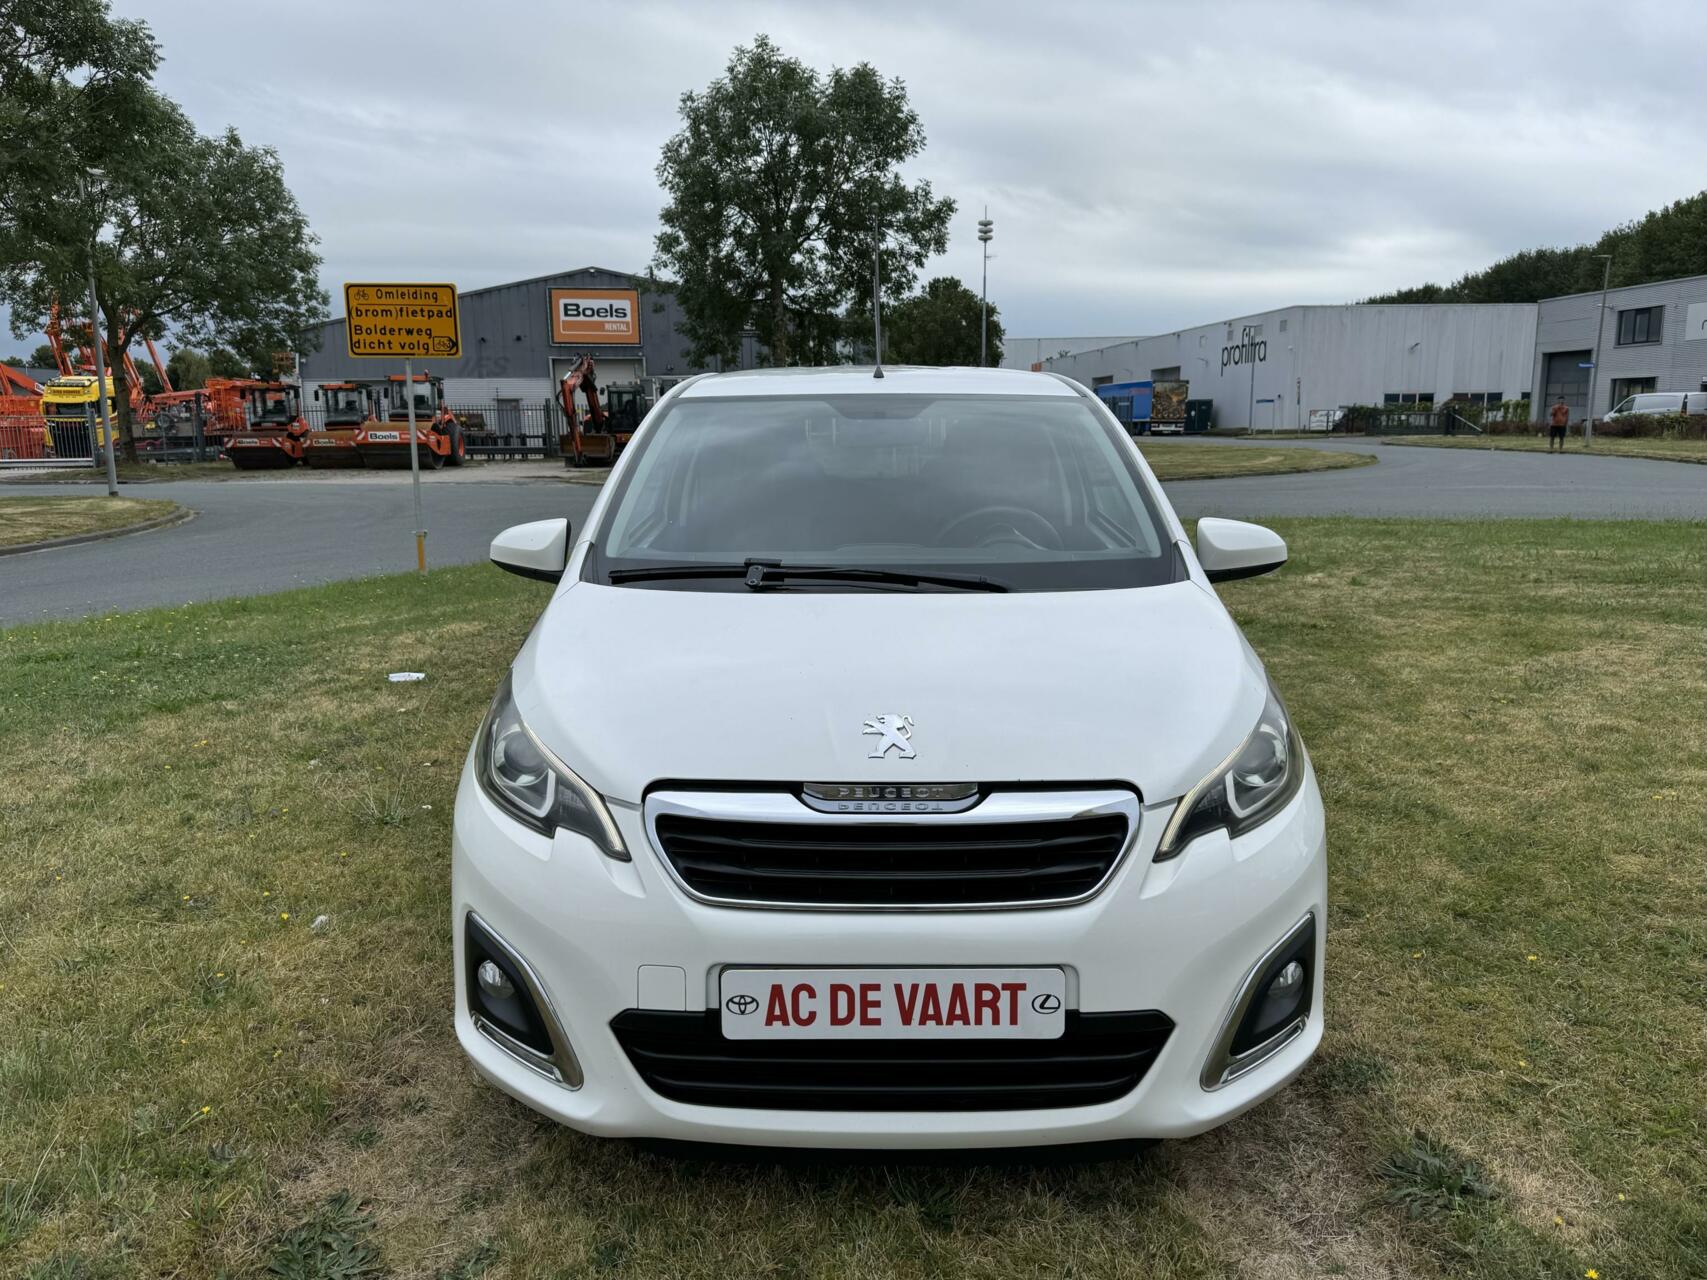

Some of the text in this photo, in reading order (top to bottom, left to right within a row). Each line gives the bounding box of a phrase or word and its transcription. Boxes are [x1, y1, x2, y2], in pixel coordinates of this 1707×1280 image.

[375, 288, 438, 303] Omleiding
[350, 306, 453, 320] (brom)fietpad
[563, 303, 628, 318] Boels
[354, 324, 433, 339] Bolderweg
[604, 322, 628, 331] RENTAL
[354, 339, 430, 354] dicht volg
[1221, 326, 1267, 377] profiltra
[369, 432, 398, 440] Boels
[837, 787, 944, 798] PEUGEOT
[764, 982, 1027, 1027] AC DE VAART
